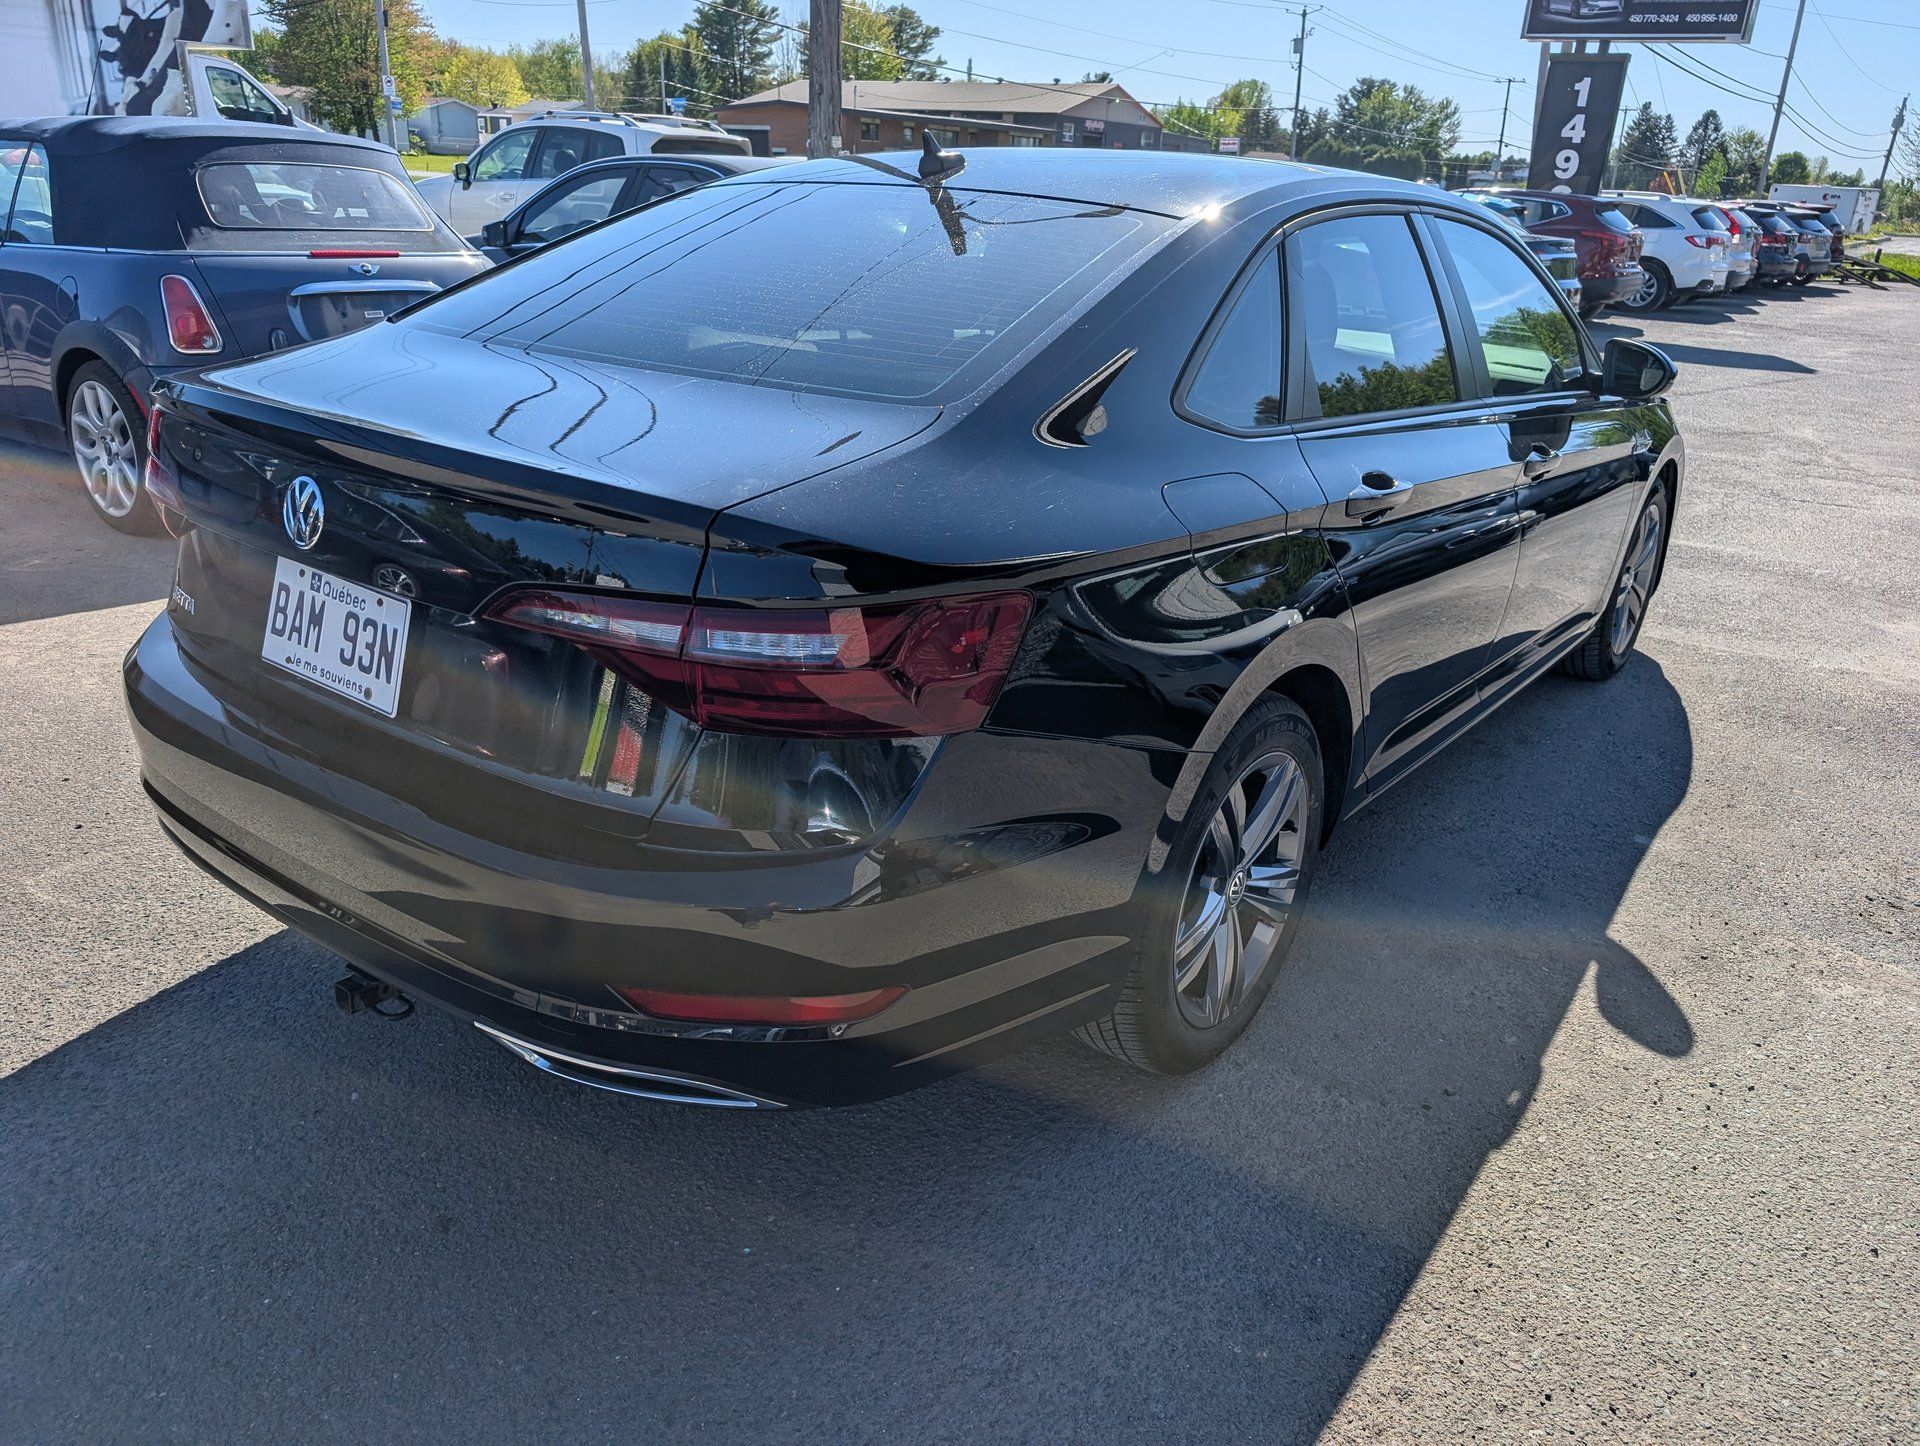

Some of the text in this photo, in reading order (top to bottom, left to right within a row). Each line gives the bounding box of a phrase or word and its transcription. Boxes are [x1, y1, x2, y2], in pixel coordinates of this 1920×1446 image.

[1629, 13, 1738, 23] 450 770-2424 450 956-1400
[1551, 77, 1592, 195] 149
[322, 580, 367, 611] Québec
[270, 581, 399, 684] BAM 93N
[291, 652, 363, 695] Je me souviens
